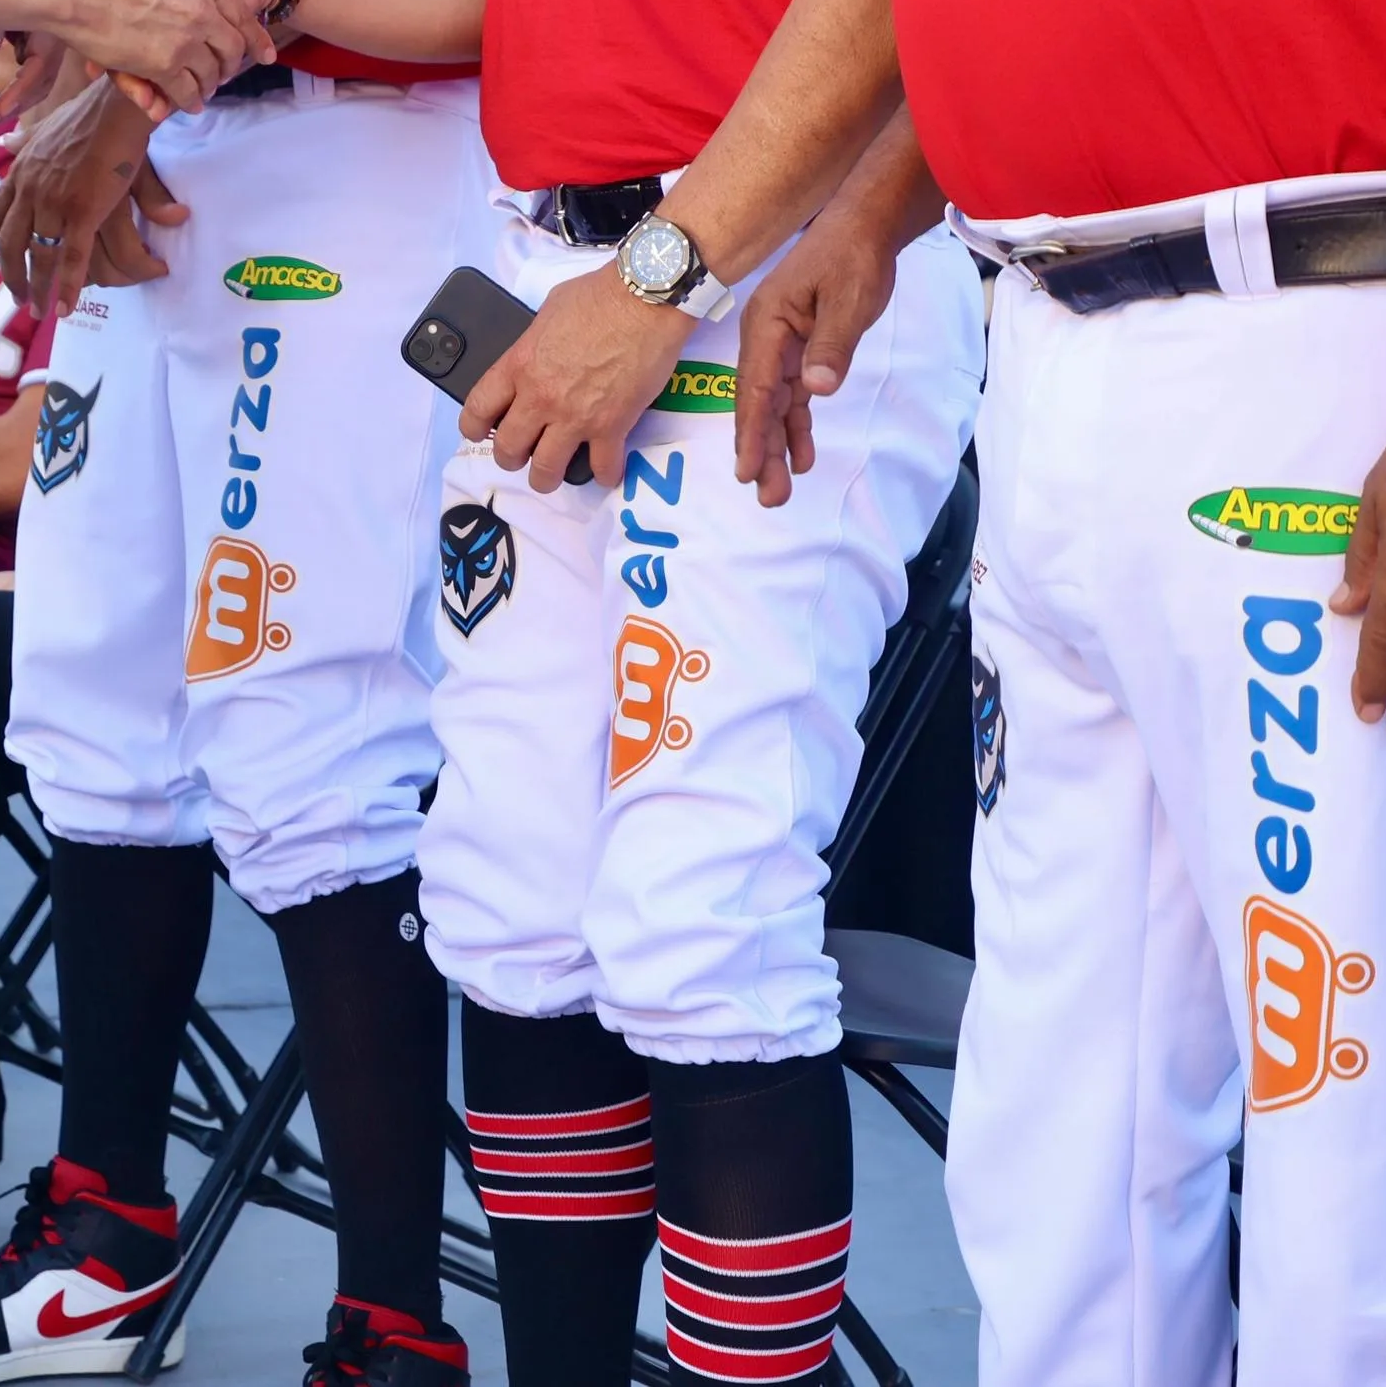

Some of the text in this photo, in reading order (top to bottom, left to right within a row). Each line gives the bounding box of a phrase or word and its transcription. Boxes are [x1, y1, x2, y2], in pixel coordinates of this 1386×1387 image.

[239, 258, 341, 293] Amacsa
[616, 449, 686, 741] merz
[1217, 487, 1360, 535] Amacs
[1241, 594, 1324, 1067] merza
